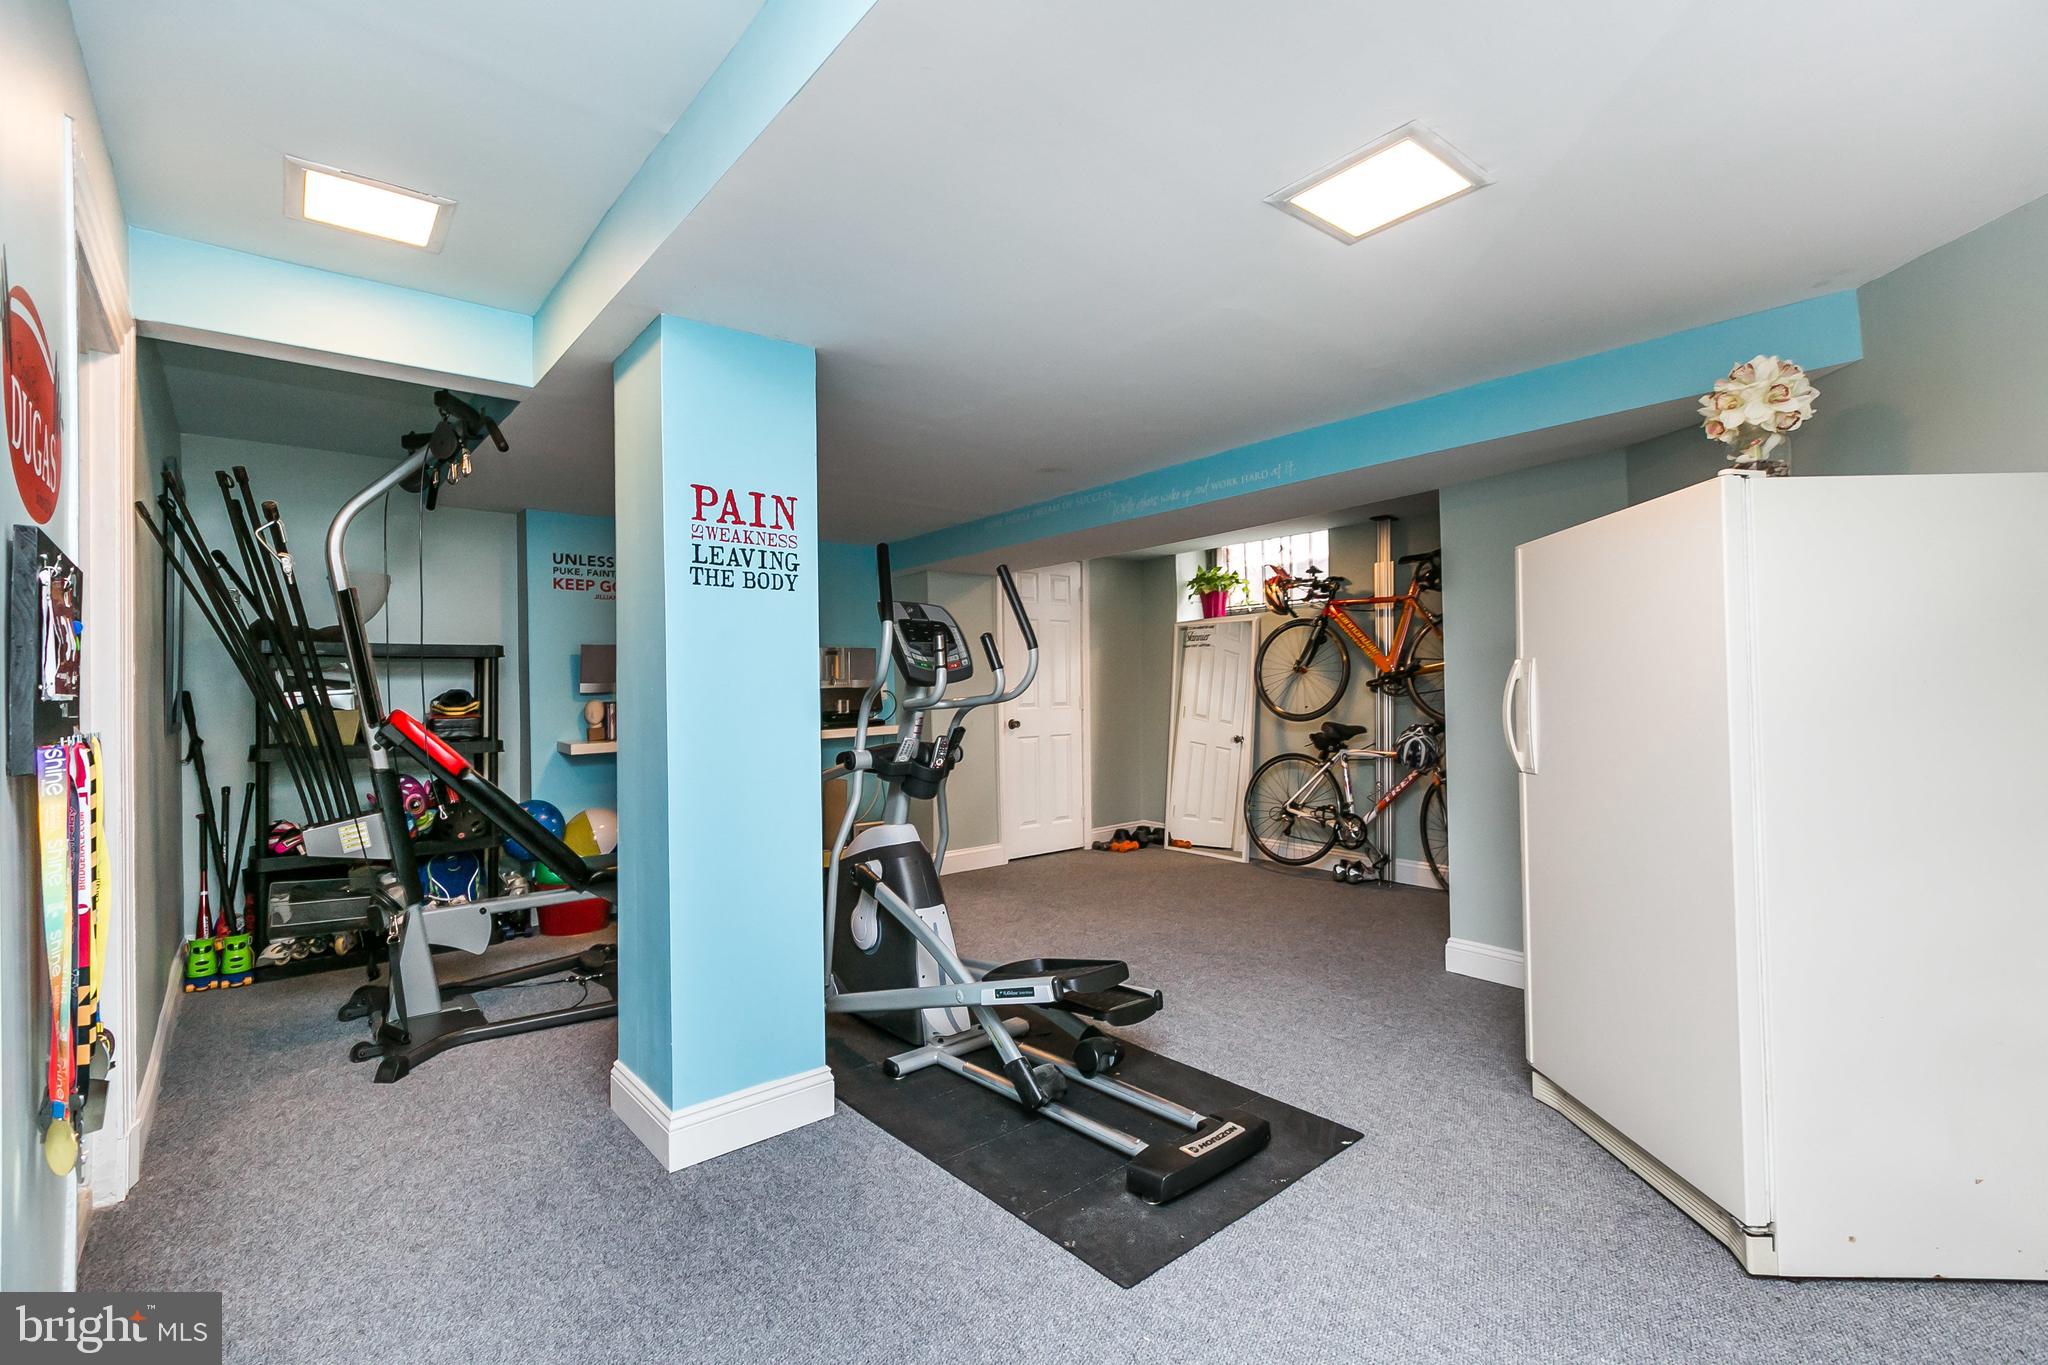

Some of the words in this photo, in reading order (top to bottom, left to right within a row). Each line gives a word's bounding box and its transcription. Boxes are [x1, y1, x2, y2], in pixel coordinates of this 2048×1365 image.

[11, 374, 57, 493] DUGAS
[1241, 470, 1268, 484] HARD
[690, 484, 798, 531] PAIN
[692, 524, 703, 541] IS
[705, 525, 798, 549] WEAKNESS
[553, 553, 614, 568] UNLESS
[692, 543, 800, 572] LEAVING
[553, 567, 583, 576] PUKE,
[553, 577, 595, 591] KEEP
[690, 566, 734, 587] THE
[742, 571, 798, 592] BODY
[44, 748, 66, 796] shine
[47, 839, 63, 886] shine
[50, 928, 63, 977] shine
[1198, 1125, 1238, 1149] HORIZON
